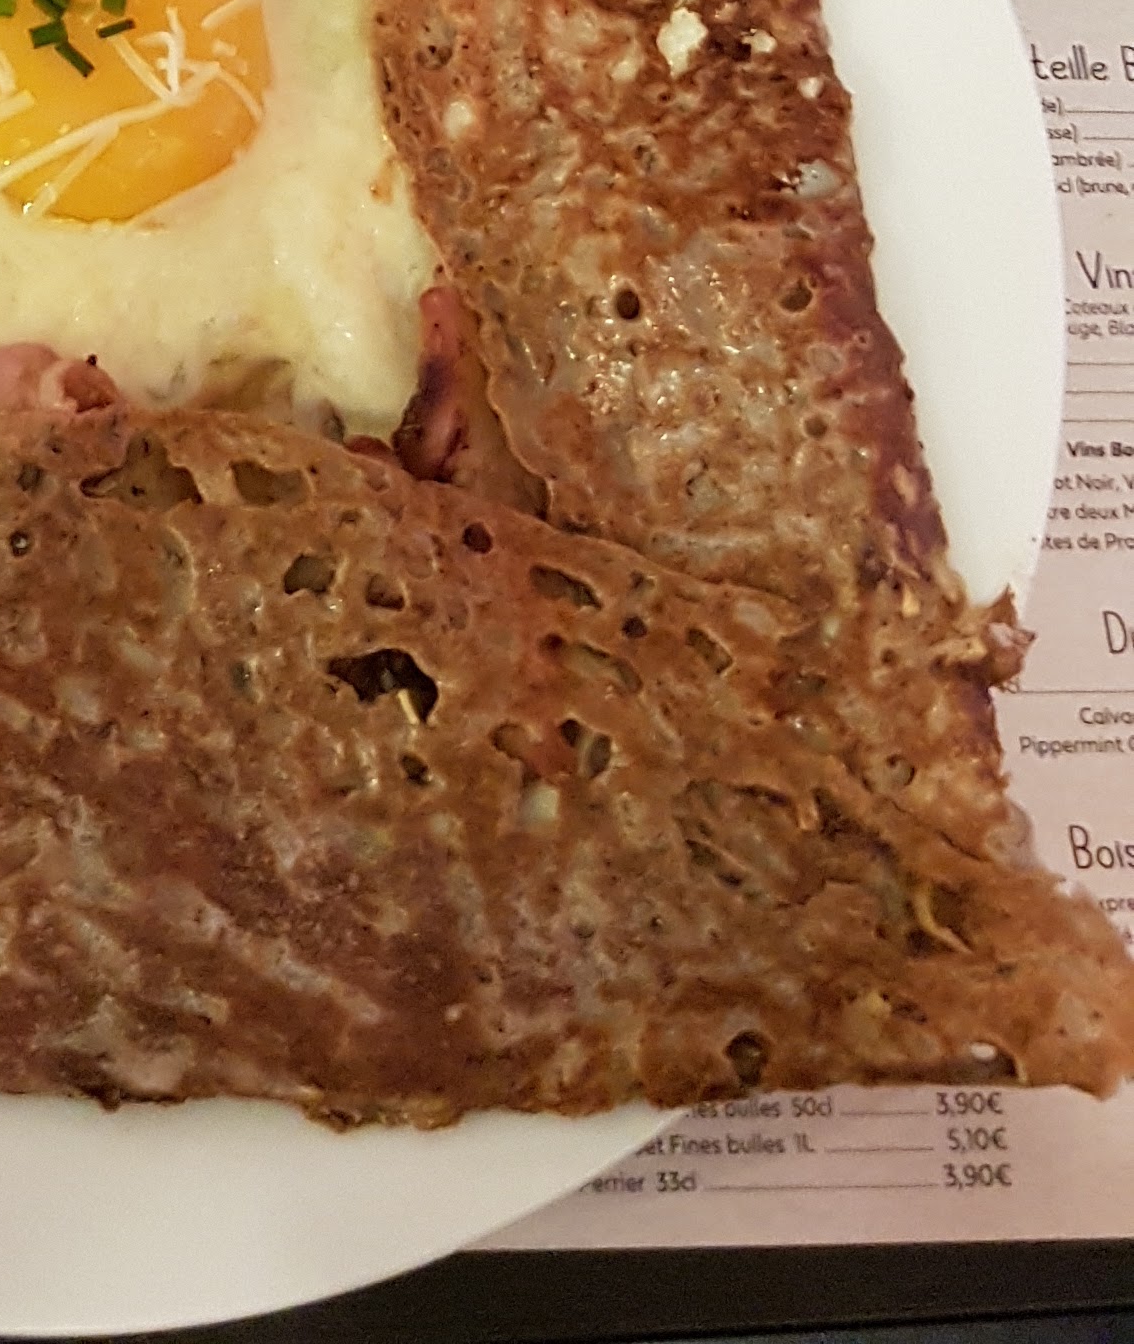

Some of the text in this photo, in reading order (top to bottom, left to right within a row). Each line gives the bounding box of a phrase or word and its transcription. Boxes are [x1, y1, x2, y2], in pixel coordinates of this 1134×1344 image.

[935, 1091, 1005, 1114] 3,90€
[669, 1127, 1008, 1155] Fines bulles 5,10€
[942, 1163, 1013, 1188] 3,90€
